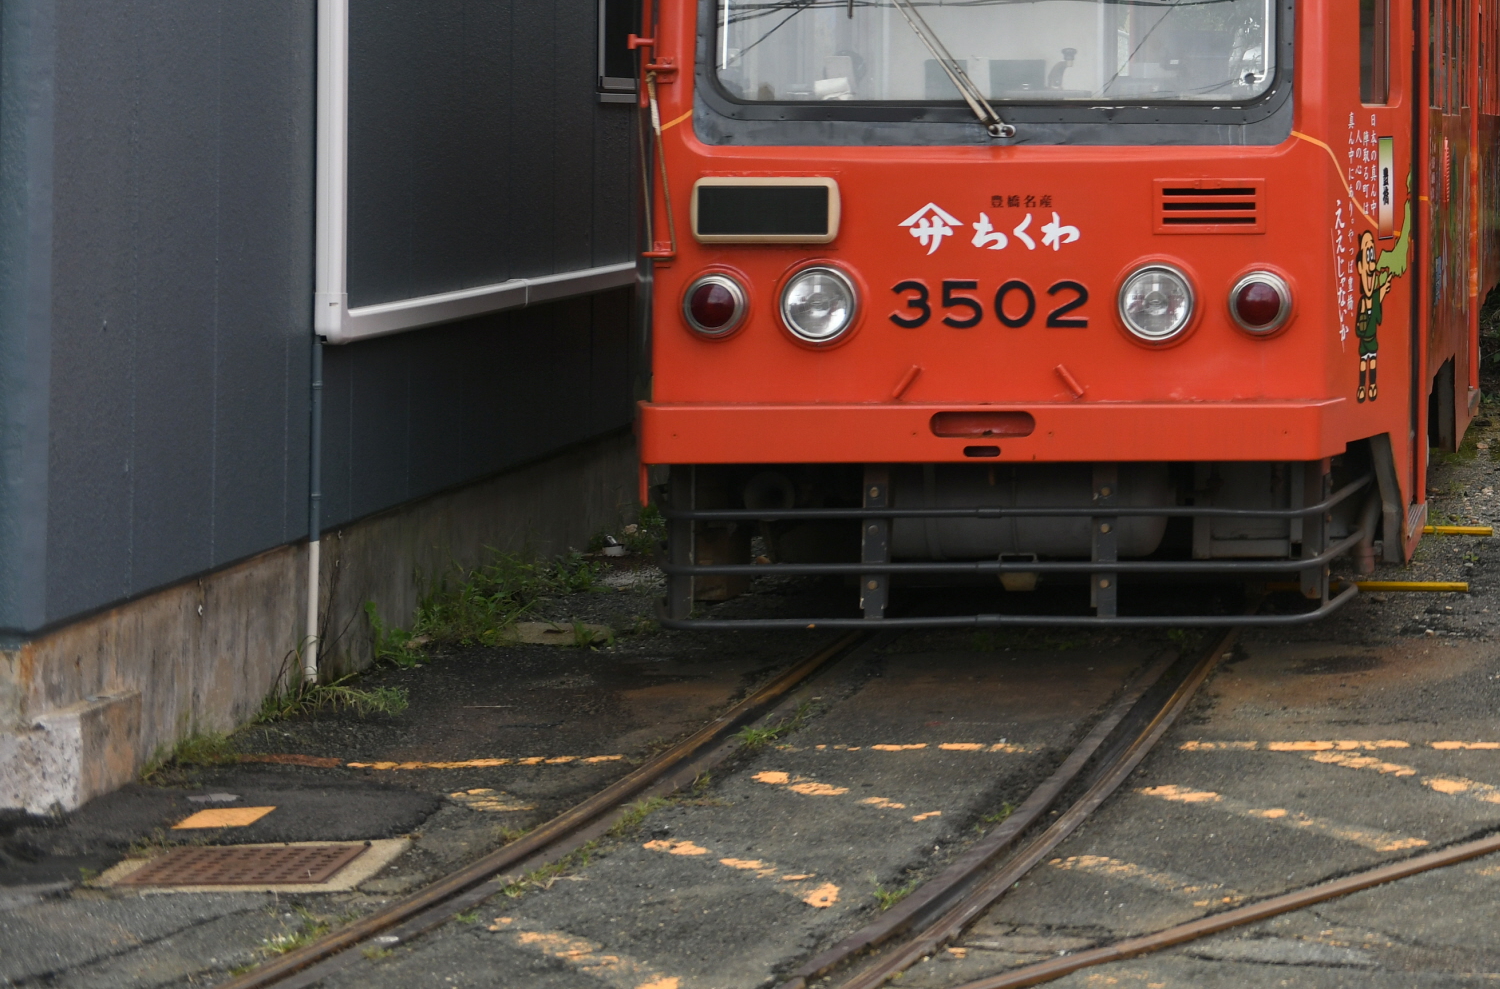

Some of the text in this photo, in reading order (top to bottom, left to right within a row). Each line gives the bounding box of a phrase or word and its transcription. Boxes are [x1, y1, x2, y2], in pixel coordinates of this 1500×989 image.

[1370, 114, 1378, 216] 日本の真ん中
[990, 195, 1053, 208] 豊橋名産
[971, 211, 1081, 252] ちくわ
[1335, 199, 1349, 342] ええじゃないか
[888, 279, 1089, 329] 3502
